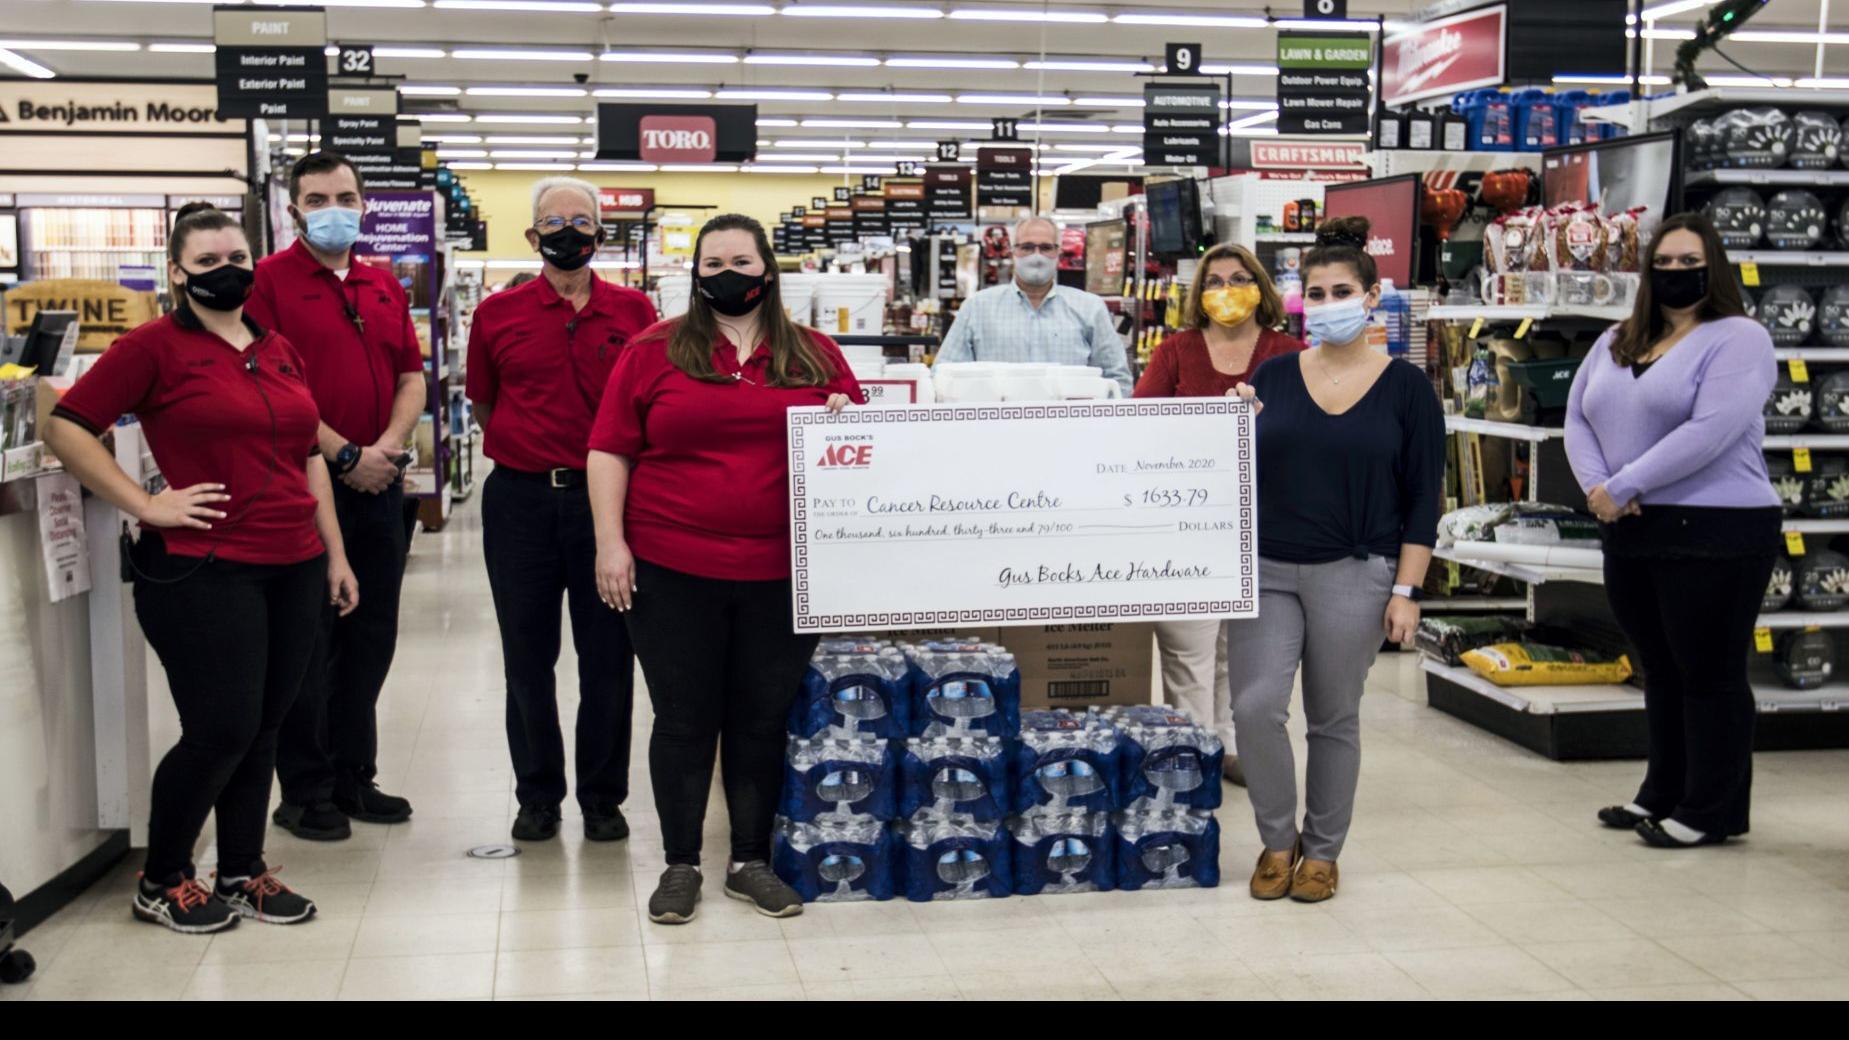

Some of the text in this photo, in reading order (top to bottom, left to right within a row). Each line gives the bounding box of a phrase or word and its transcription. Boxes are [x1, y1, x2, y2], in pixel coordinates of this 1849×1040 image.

[252, 22, 290, 34] PAINT
[1176, 48, 1191, 70] 9
[1280, 48, 1368, 61] LAWN & GARDEN
[240, 56, 305, 66] Interior Paint
[343, 50, 370, 72] 32
[239, 78, 305, 90] Exterior Paint
[1281, 76, 1312, 85] Outdoor
[1314, 76, 1339, 85] Power
[1153, 96, 1212, 106] AUTOMOTIVE
[1283, 98, 1363, 108] Lawn Mower Repair
[18, 100, 138, 126] Benjamin
[260, 103, 287, 114] Paint
[996, 122, 1013, 137] 11
[1153, 119, 1169, 128] Auto
[1304, 120, 1343, 129] Gas Cans
[940, 144, 957, 158] 12
[1258, 146, 1360, 163] CRAFTSMAN
[899, 162, 914, 176] 13
[865, 177, 880, 188] 14
[836, 189, 849, 200] 15
[366, 198, 432, 215] juvenate
[375, 224, 408, 233] HOME
[12, 298, 128, 322] TWINE
[1764, 304, 1779, 314] 50
[1552, 370, 1570, 380] ACE
[816, 442, 874, 466] ACE
[1096, 456, 1216, 474] DATE November 2020
[813, 486, 1208, 514] PAY TO Cancer Resource Centre $ 1633.79
[814, 528, 833, 540] One
[888, 530, 902, 538] six
[954, 522, 1014, 540] thirty-three
[1016, 522, 1034, 534] and
[1038, 521, 1073, 535] 79/100
[1178, 520, 1234, 532] DOLLARS
[1000, 559, 1212, 590] Gus Bocks Ace Hardware
[1044, 622, 1114, 632] Ice Melter
